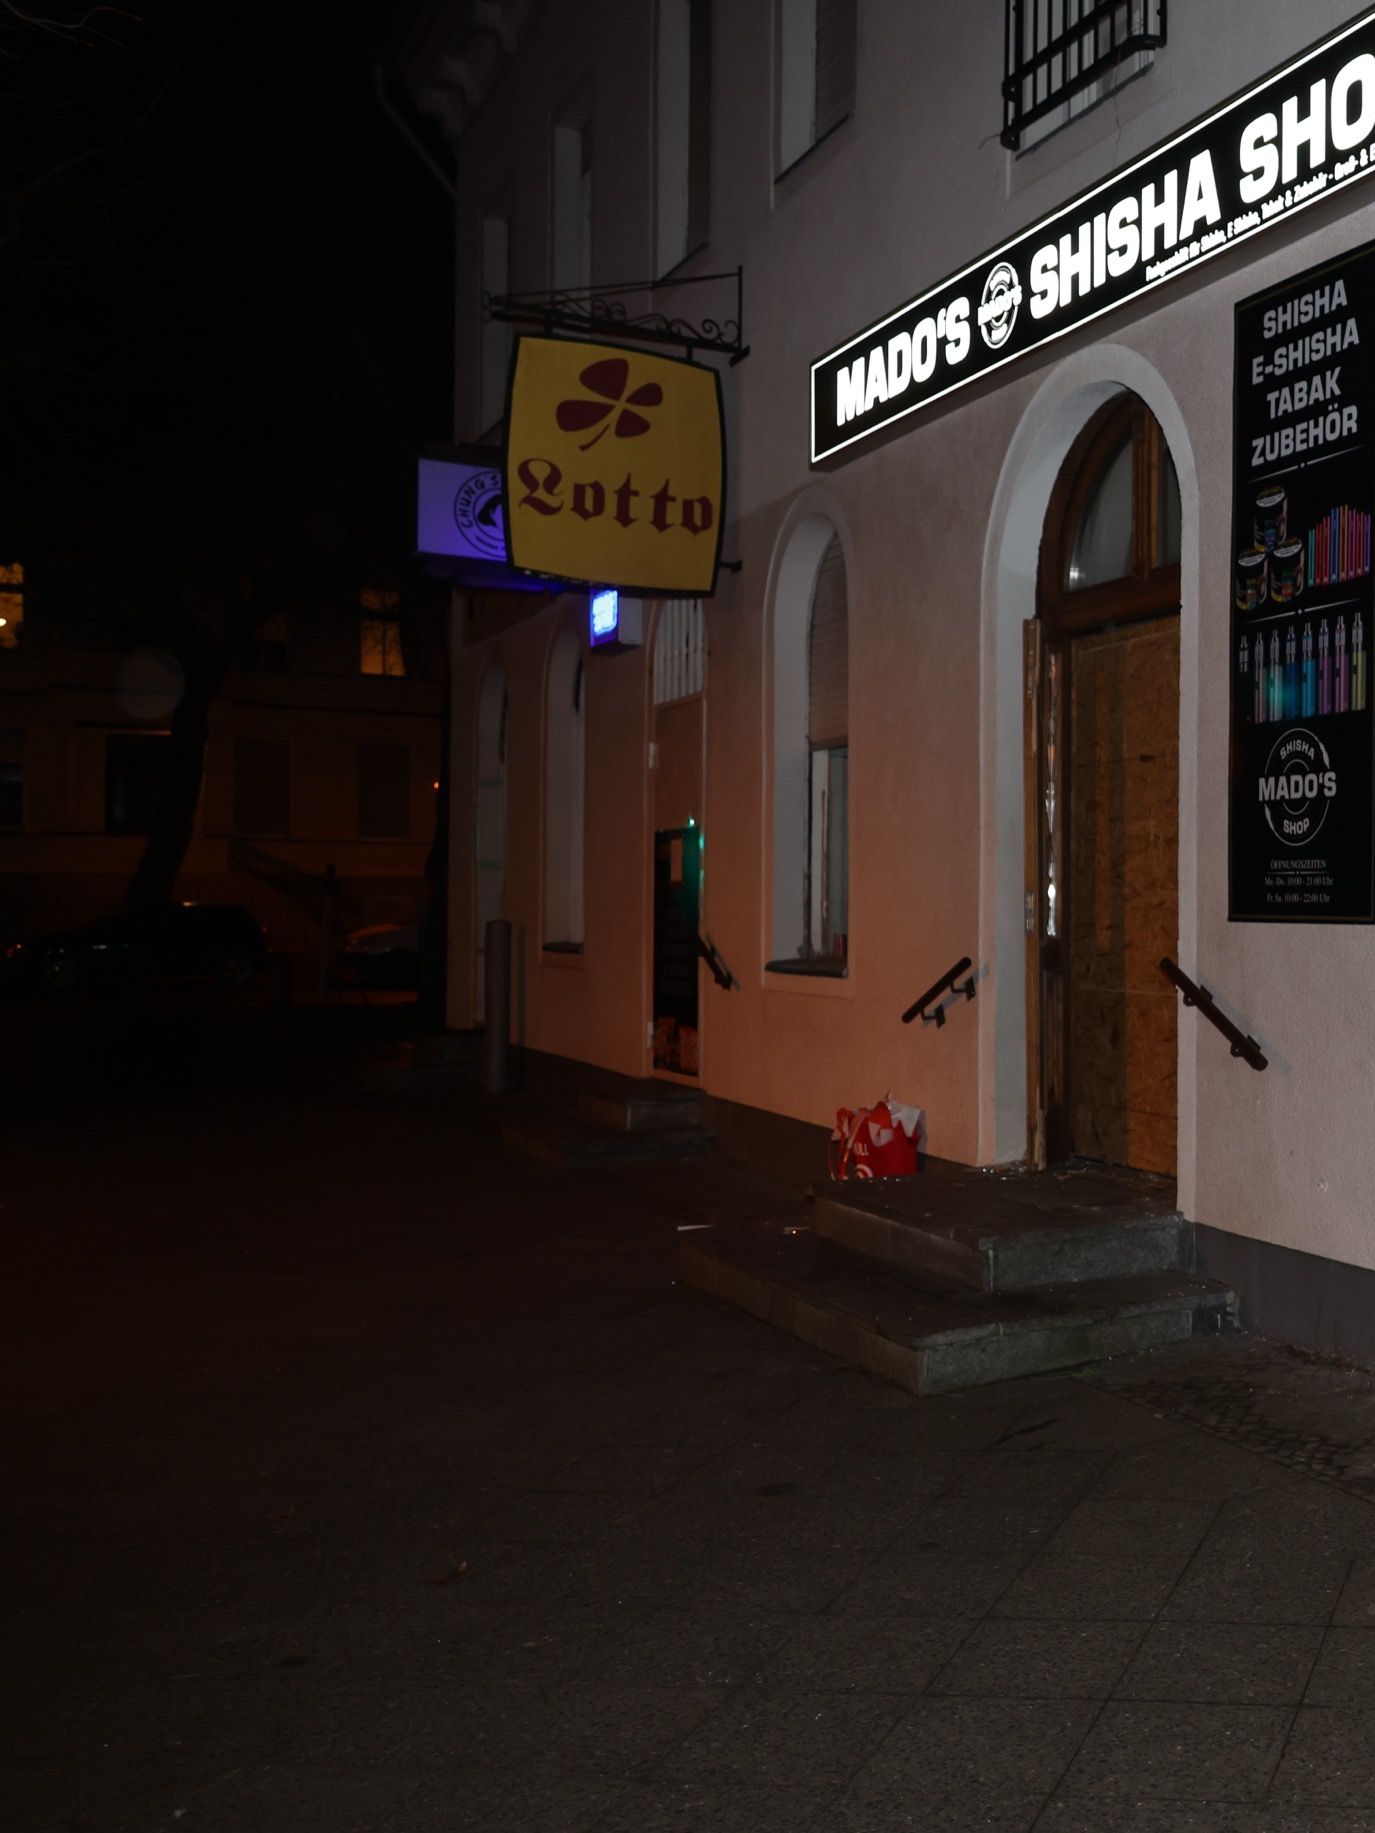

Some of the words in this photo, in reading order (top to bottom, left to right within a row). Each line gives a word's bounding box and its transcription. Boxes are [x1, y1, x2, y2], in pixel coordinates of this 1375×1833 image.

[1029, 148, 1222, 320] SHISHA
[1262, 279, 1348, 340] SHISHA
[1251, 317, 1360, 386] E-SHISHA
[1266, 366, 1342, 420] TABAK
[1251, 403, 1358, 467] ZUBEHÖR
[517, 457, 714, 536] Lotto
[1280, 739, 1315, 760] SHISHA
[1282, 817, 1310, 835] SHOP
